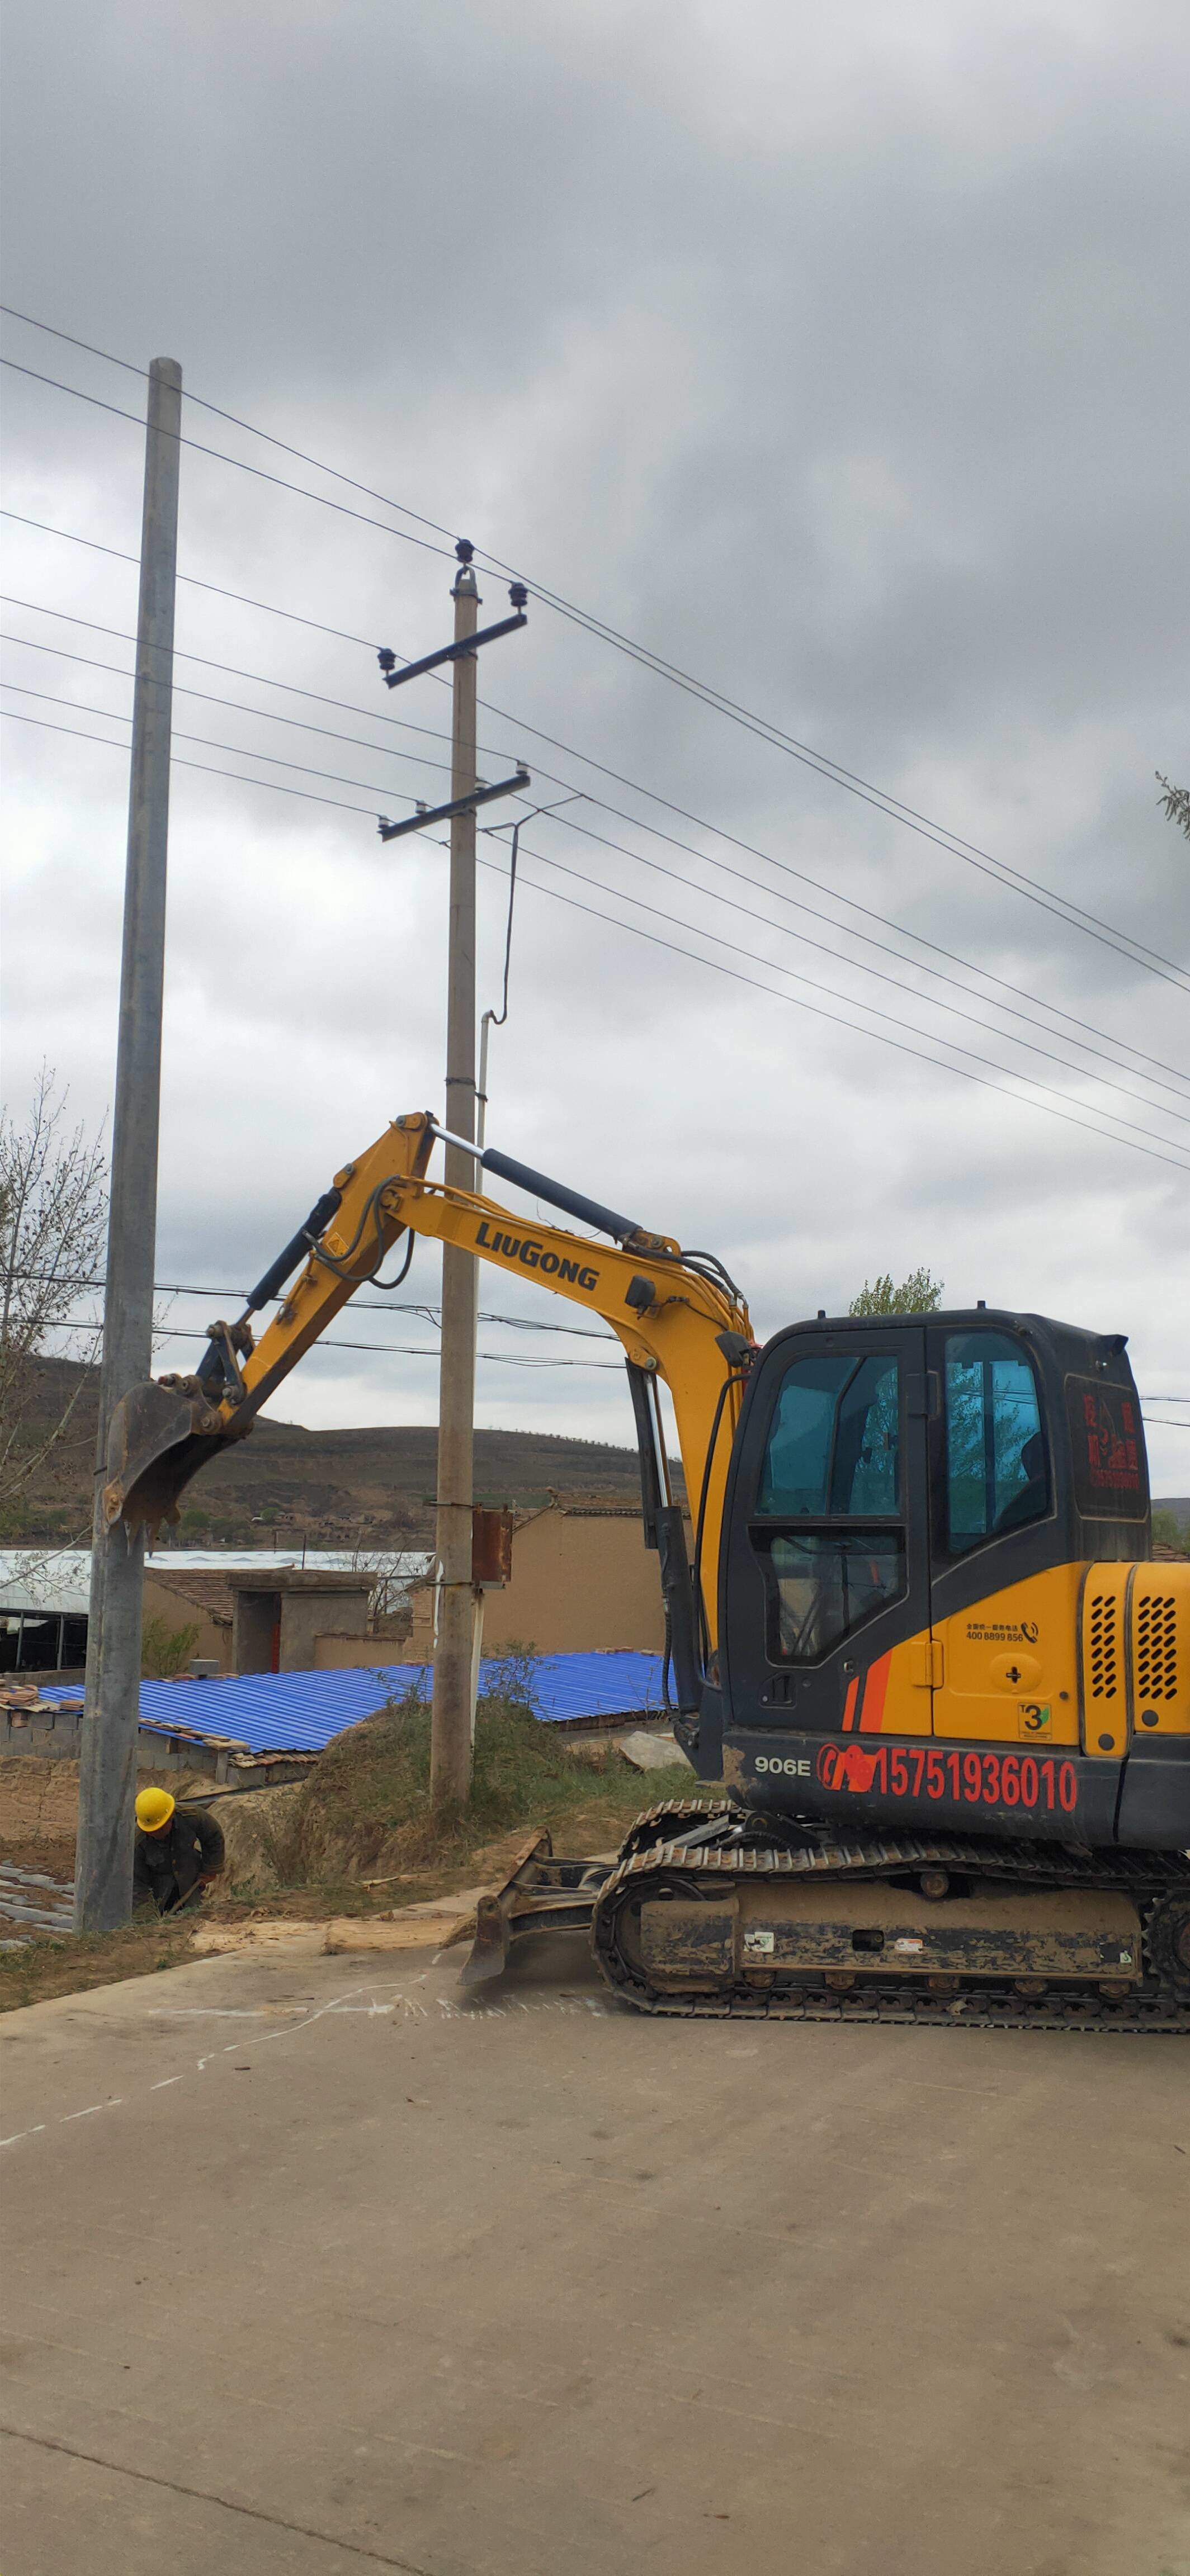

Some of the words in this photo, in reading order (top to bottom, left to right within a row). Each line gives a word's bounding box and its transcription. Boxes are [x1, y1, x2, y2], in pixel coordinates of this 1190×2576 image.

[966, 1631, 983, 1640] 400
[1007, 1633, 1023, 1642] 856
[755, 1756, 811, 1777] 906E
[876, 1747, 1076, 1812] 15751936010
